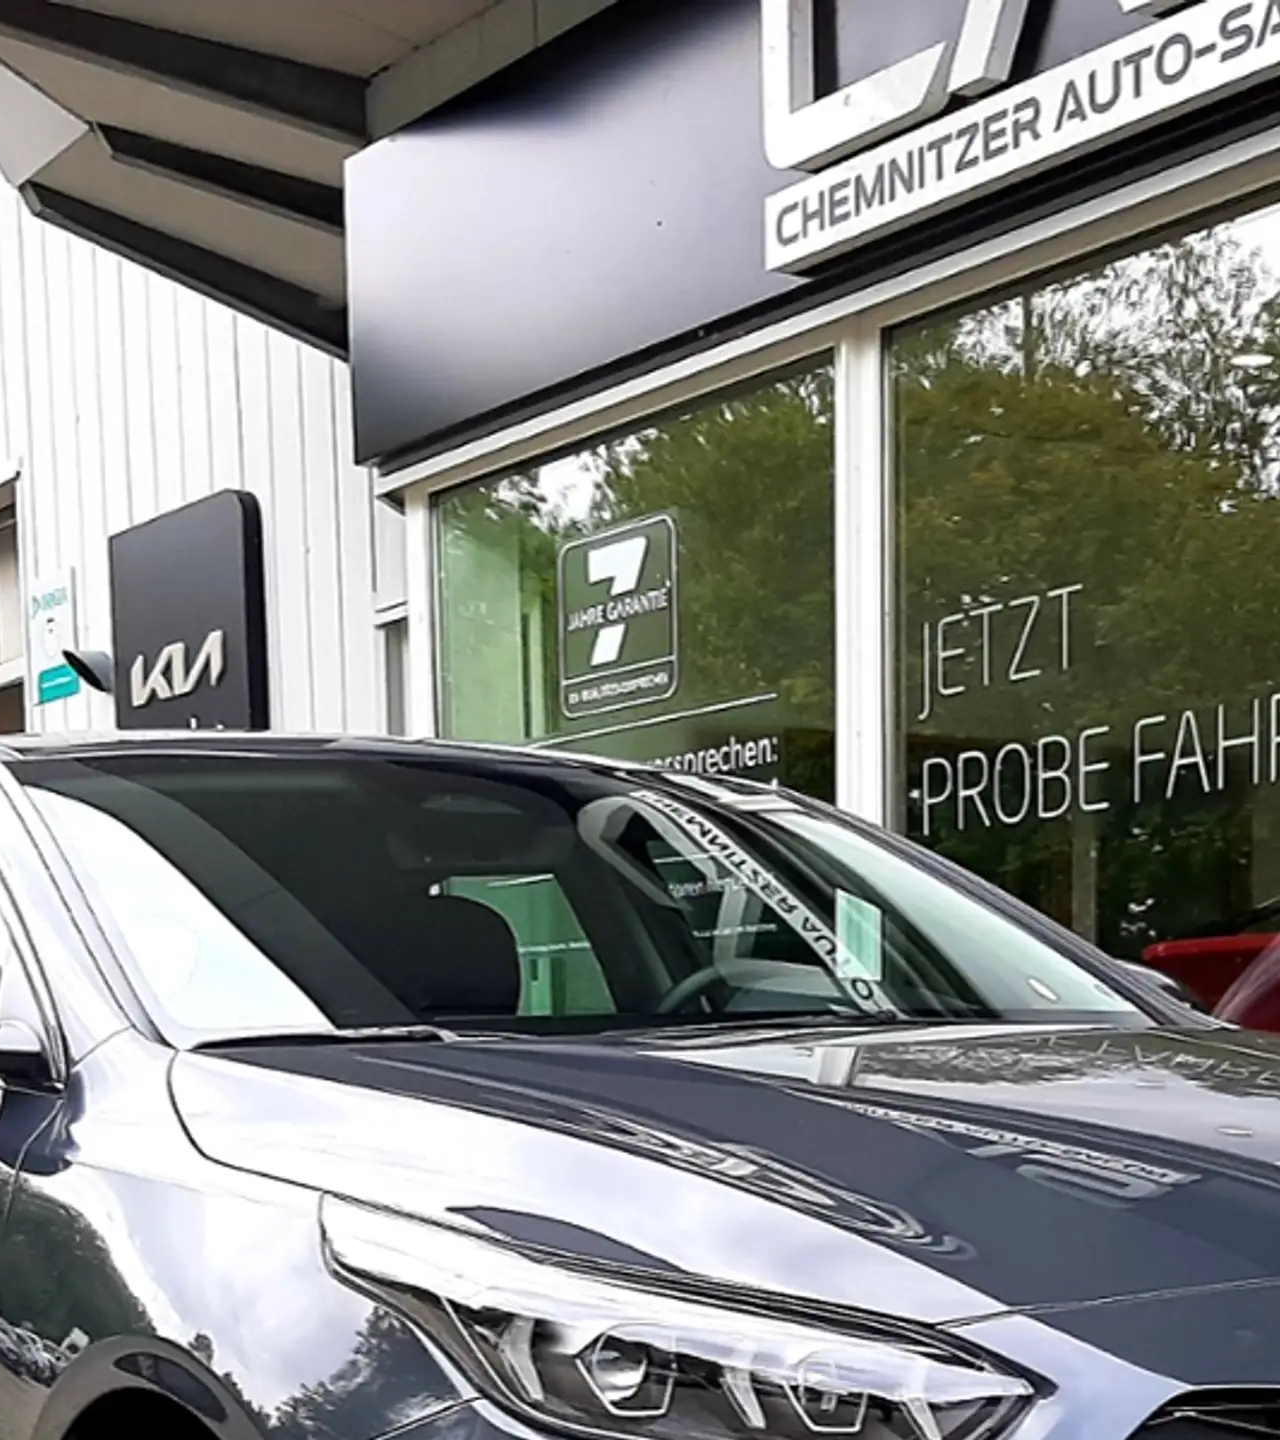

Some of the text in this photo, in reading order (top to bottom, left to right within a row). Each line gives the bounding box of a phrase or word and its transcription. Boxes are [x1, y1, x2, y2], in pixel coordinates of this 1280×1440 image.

[775, 97, 1041, 247] CHEMNITZER
[130, 629, 224, 708] KIA
[918, 583, 1083, 720] JETZT
[922, 726, 1110, 836] PROBE
